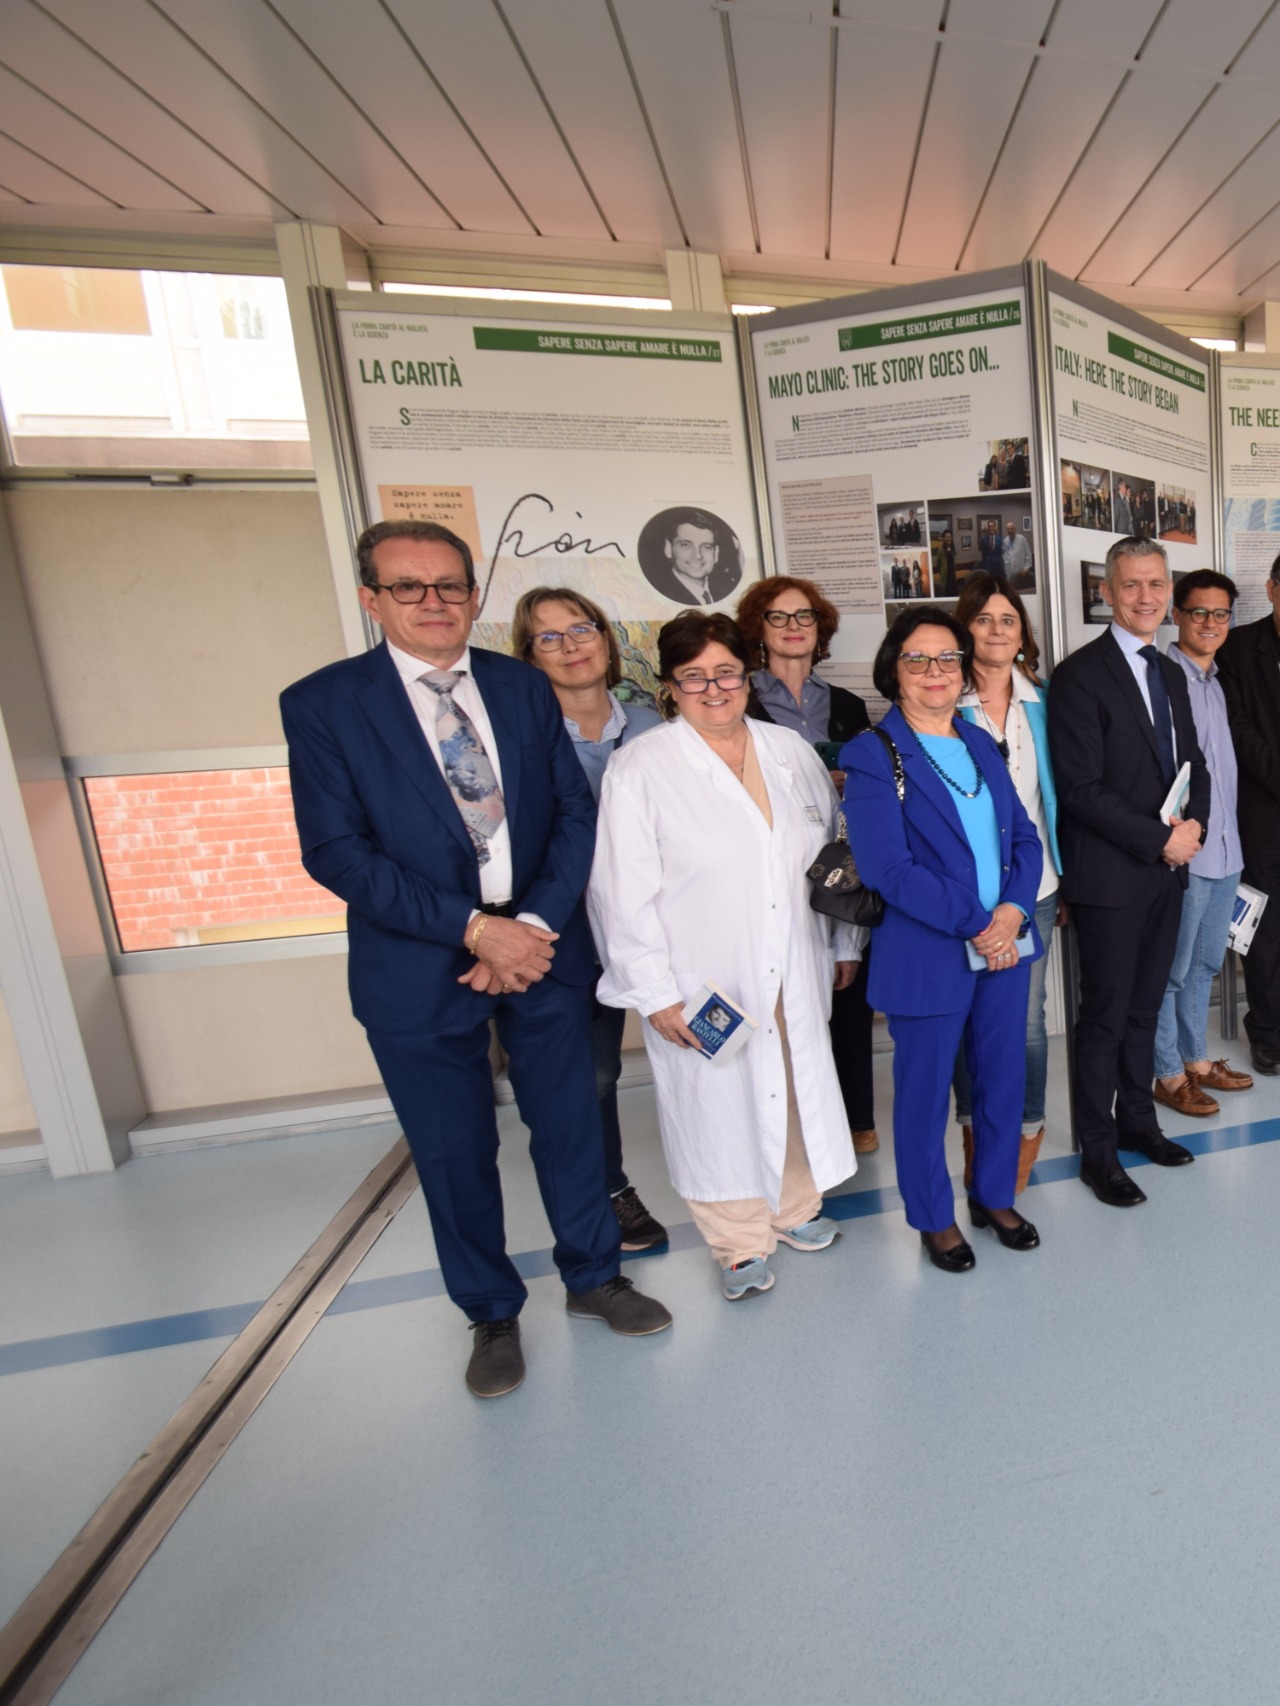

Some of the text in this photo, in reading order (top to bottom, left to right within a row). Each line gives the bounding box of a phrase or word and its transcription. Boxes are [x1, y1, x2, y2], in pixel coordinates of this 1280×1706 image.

[881, 325, 905, 340] SAPERE
[906, 322, 928, 336] SENZA
[928, 318, 954, 332] SAPERE
[955, 314, 979, 328] AMARE
[980, 310, 985, 324] È
[986, 308, 1008, 323] NULLA
[538, 336, 572, 349] SAPERE
[575, 338, 603, 351] SENZA
[605, 340, 638, 353] SAPERE
[640, 342, 670, 354] AMARE
[672, 340, 678, 355] È
[680, 344, 707, 356] NULLA
[359, 356, 463, 388] LA CARITÀ
[769, 346, 1000, 399] MAYO CLINIC: THE STORY GOES ON...
[1055, 345, 1179, 415] ITALY: HERE THE STORY BEGAN
[1229, 406, 1253, 427] THE
